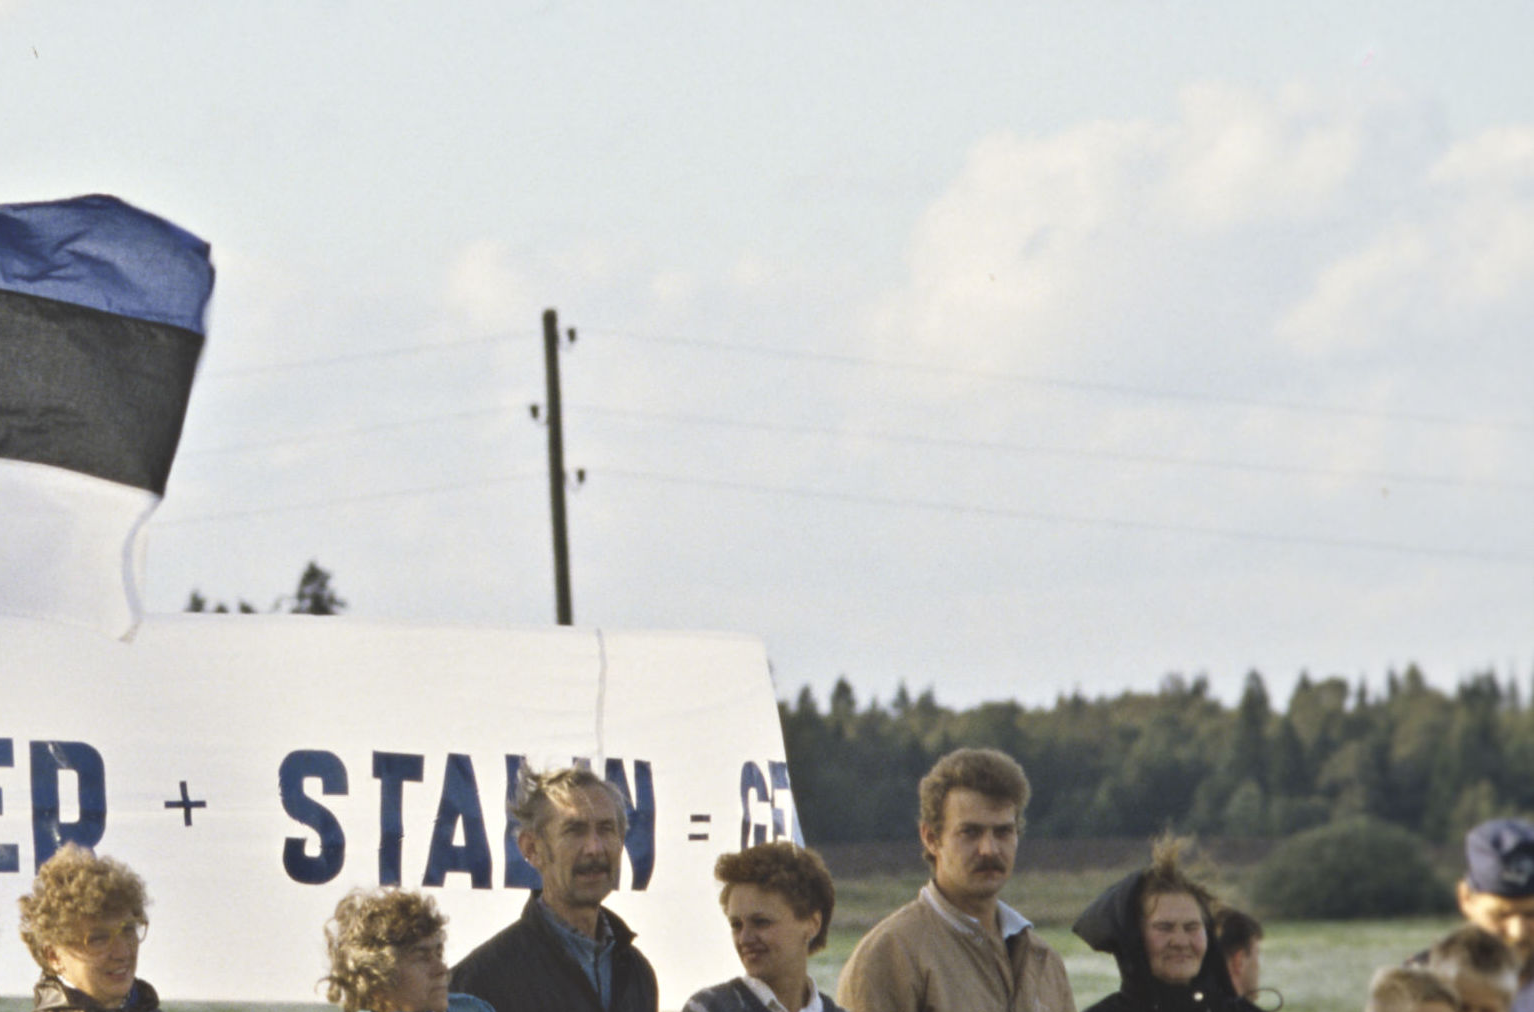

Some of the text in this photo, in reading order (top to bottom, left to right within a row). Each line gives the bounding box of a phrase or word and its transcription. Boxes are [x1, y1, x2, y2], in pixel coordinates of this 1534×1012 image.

[164, 781, 206, 826] +
[278, 748, 656, 891] STALN
[688, 814, 711, 841] =
